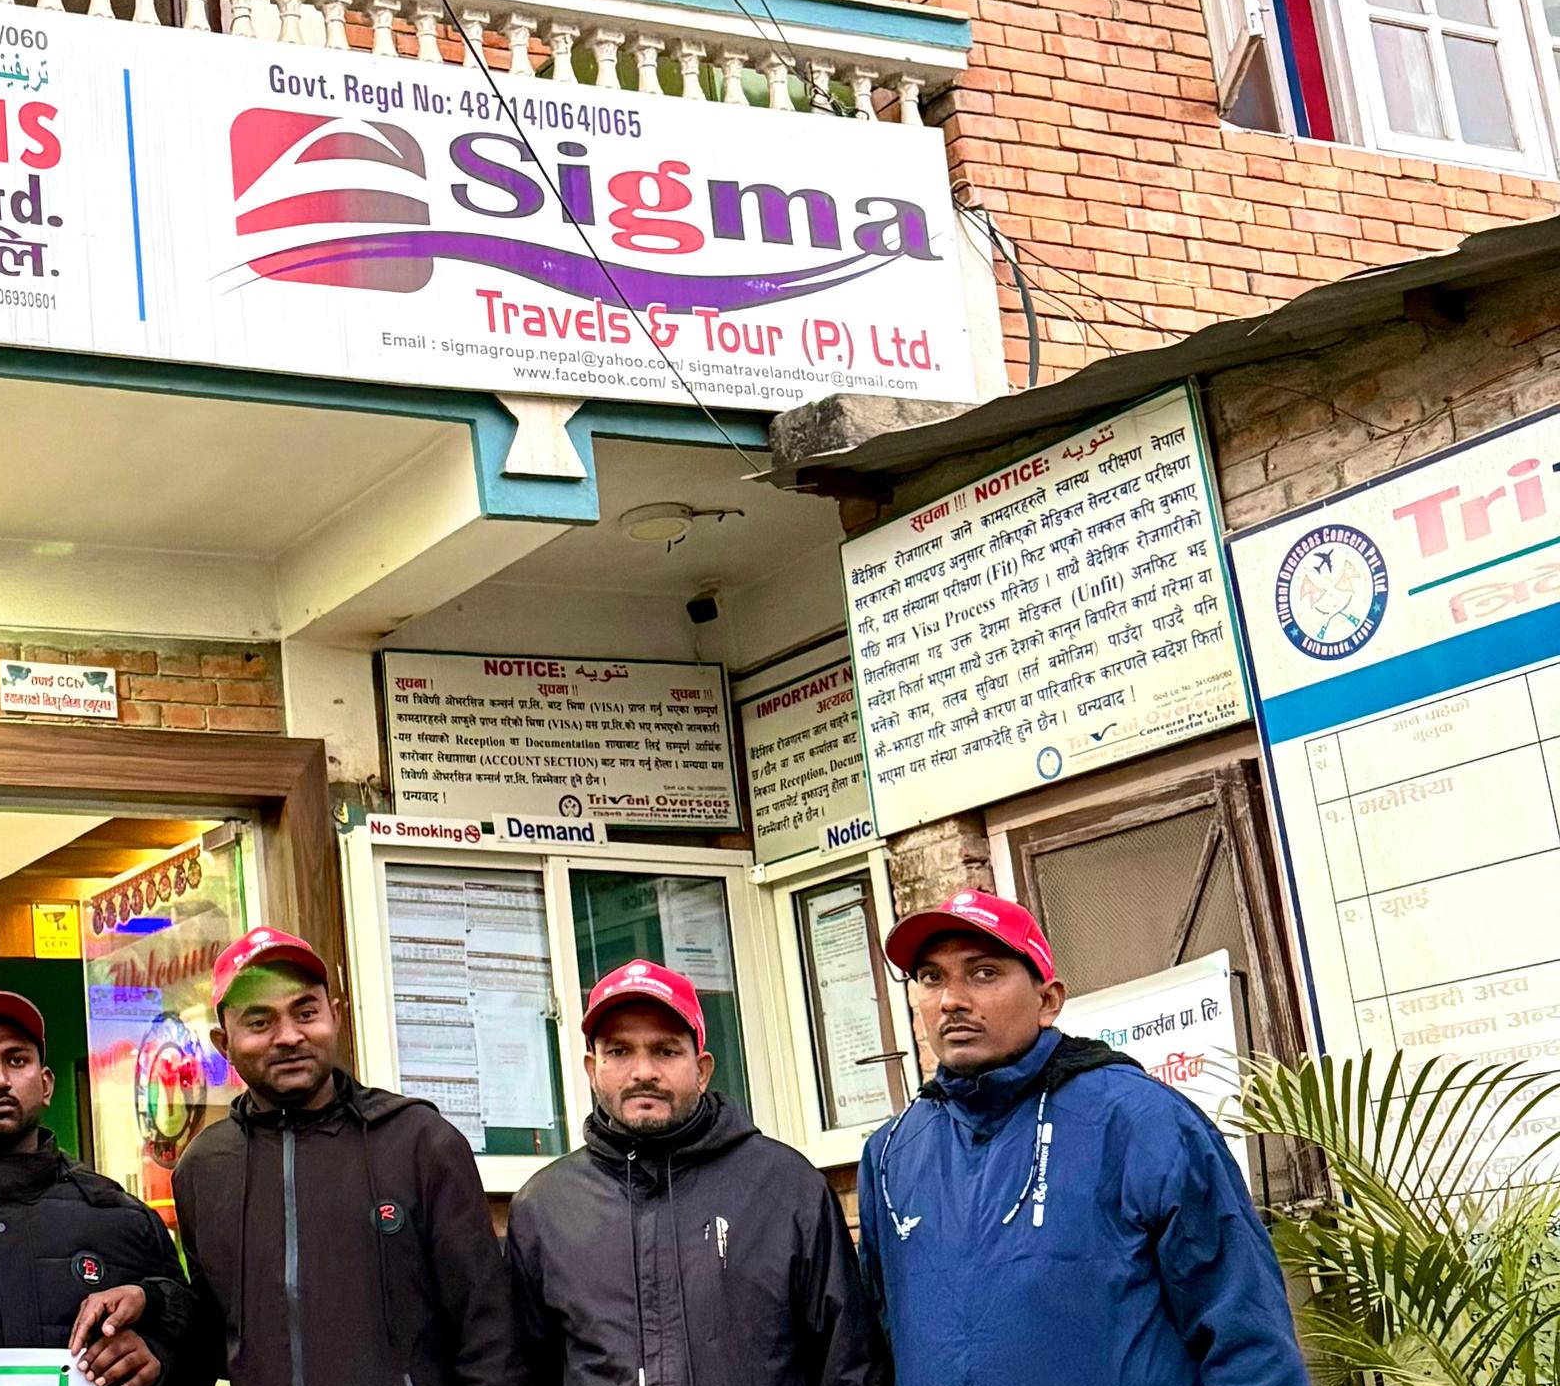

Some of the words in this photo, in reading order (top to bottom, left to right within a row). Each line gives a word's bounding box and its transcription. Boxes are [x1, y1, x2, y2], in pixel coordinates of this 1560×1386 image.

[269, 64, 335, 100] Govt.
[344, 74, 403, 114] Regd
[413, 83, 451, 115] No:
[449, 132, 943, 261] Sigma
[476, 289, 632, 344] Travels
[647, 303, 679, 347] &
[694, 308, 782, 356] Tour
[871, 324, 941, 371] Ltd.
[382, 332, 426, 350] Email
[688, 359, 918, 391] sigmatravelandtour@gmail.com
[514, 367, 666, 390] www.facebook.com/
[671, 378, 804, 402] sigmanepal.group
[975, 458, 1051, 502] NOTICE:
[852, 561, 885, 583] वैदेशिक
[895, 536, 942, 566] रोजगारमा
[950, 520, 971, 539] जाने
[1099, 446, 1141, 473] परीक्षण
[1151, 427, 1184, 449] नेपाल
[855, 579, 900, 609] सरकारको
[905, 562, 944, 587] मापदण्ड
[950, 544, 984, 569] अनुसार
[989, 520, 1035, 552] तोकिएको
[1040, 501, 1083, 527] मेडिकल
[1088, 478, 1139, 508] सेन्टरबाट
[1145, 455, 1189, 482] परीक्षण
[987, 558, 1018, 586] (Fit)
[912, 622, 940, 640] Visa
[945, 599, 995, 628] Process
[484, 660, 564, 677] NOTICE:
[757, 677, 838, 718] IMPORTANT
[456, 735, 504, 746] Reception
[526, 737, 599, 748] Documentation
[480, 755, 538, 765] (ACCOUNT
[544, 757, 597, 768] SECTION)
[371, 821, 390, 835] No
[396, 822, 462, 842] Smoking
[506, 817, 595, 842] Demand
